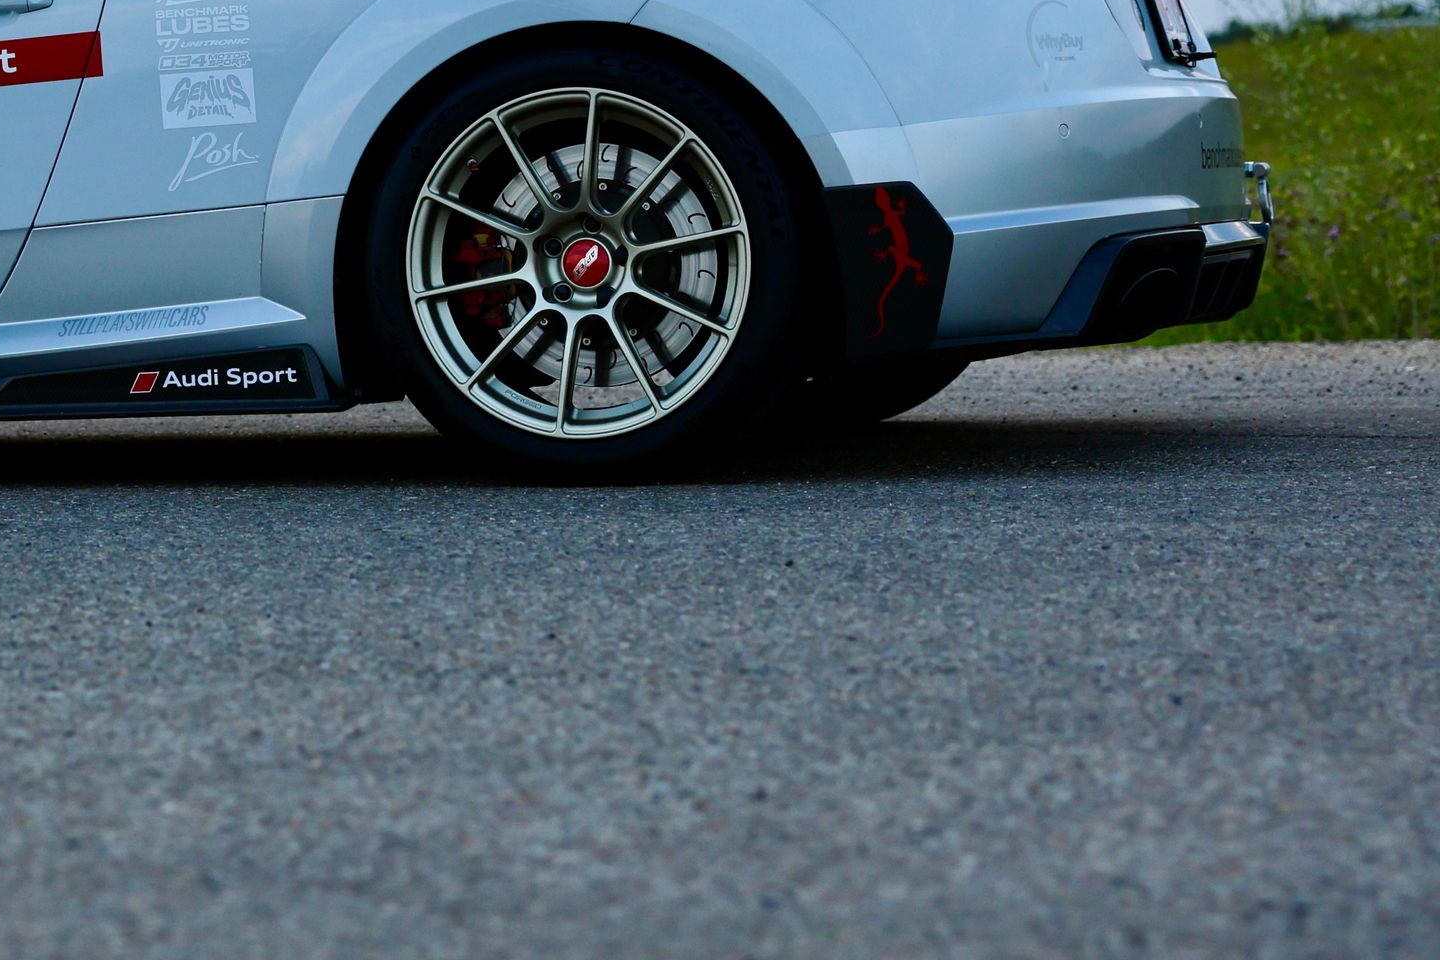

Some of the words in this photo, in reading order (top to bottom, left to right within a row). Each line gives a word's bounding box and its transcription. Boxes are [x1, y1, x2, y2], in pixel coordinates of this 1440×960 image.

[155, 4, 249, 19] BENCHMARK
[156, 14, 250, 36] LUBES
[181, 38, 250, 49] UNITRONIC
[162, 369, 219, 388] Audi
[226, 367, 297, 388] Sport
